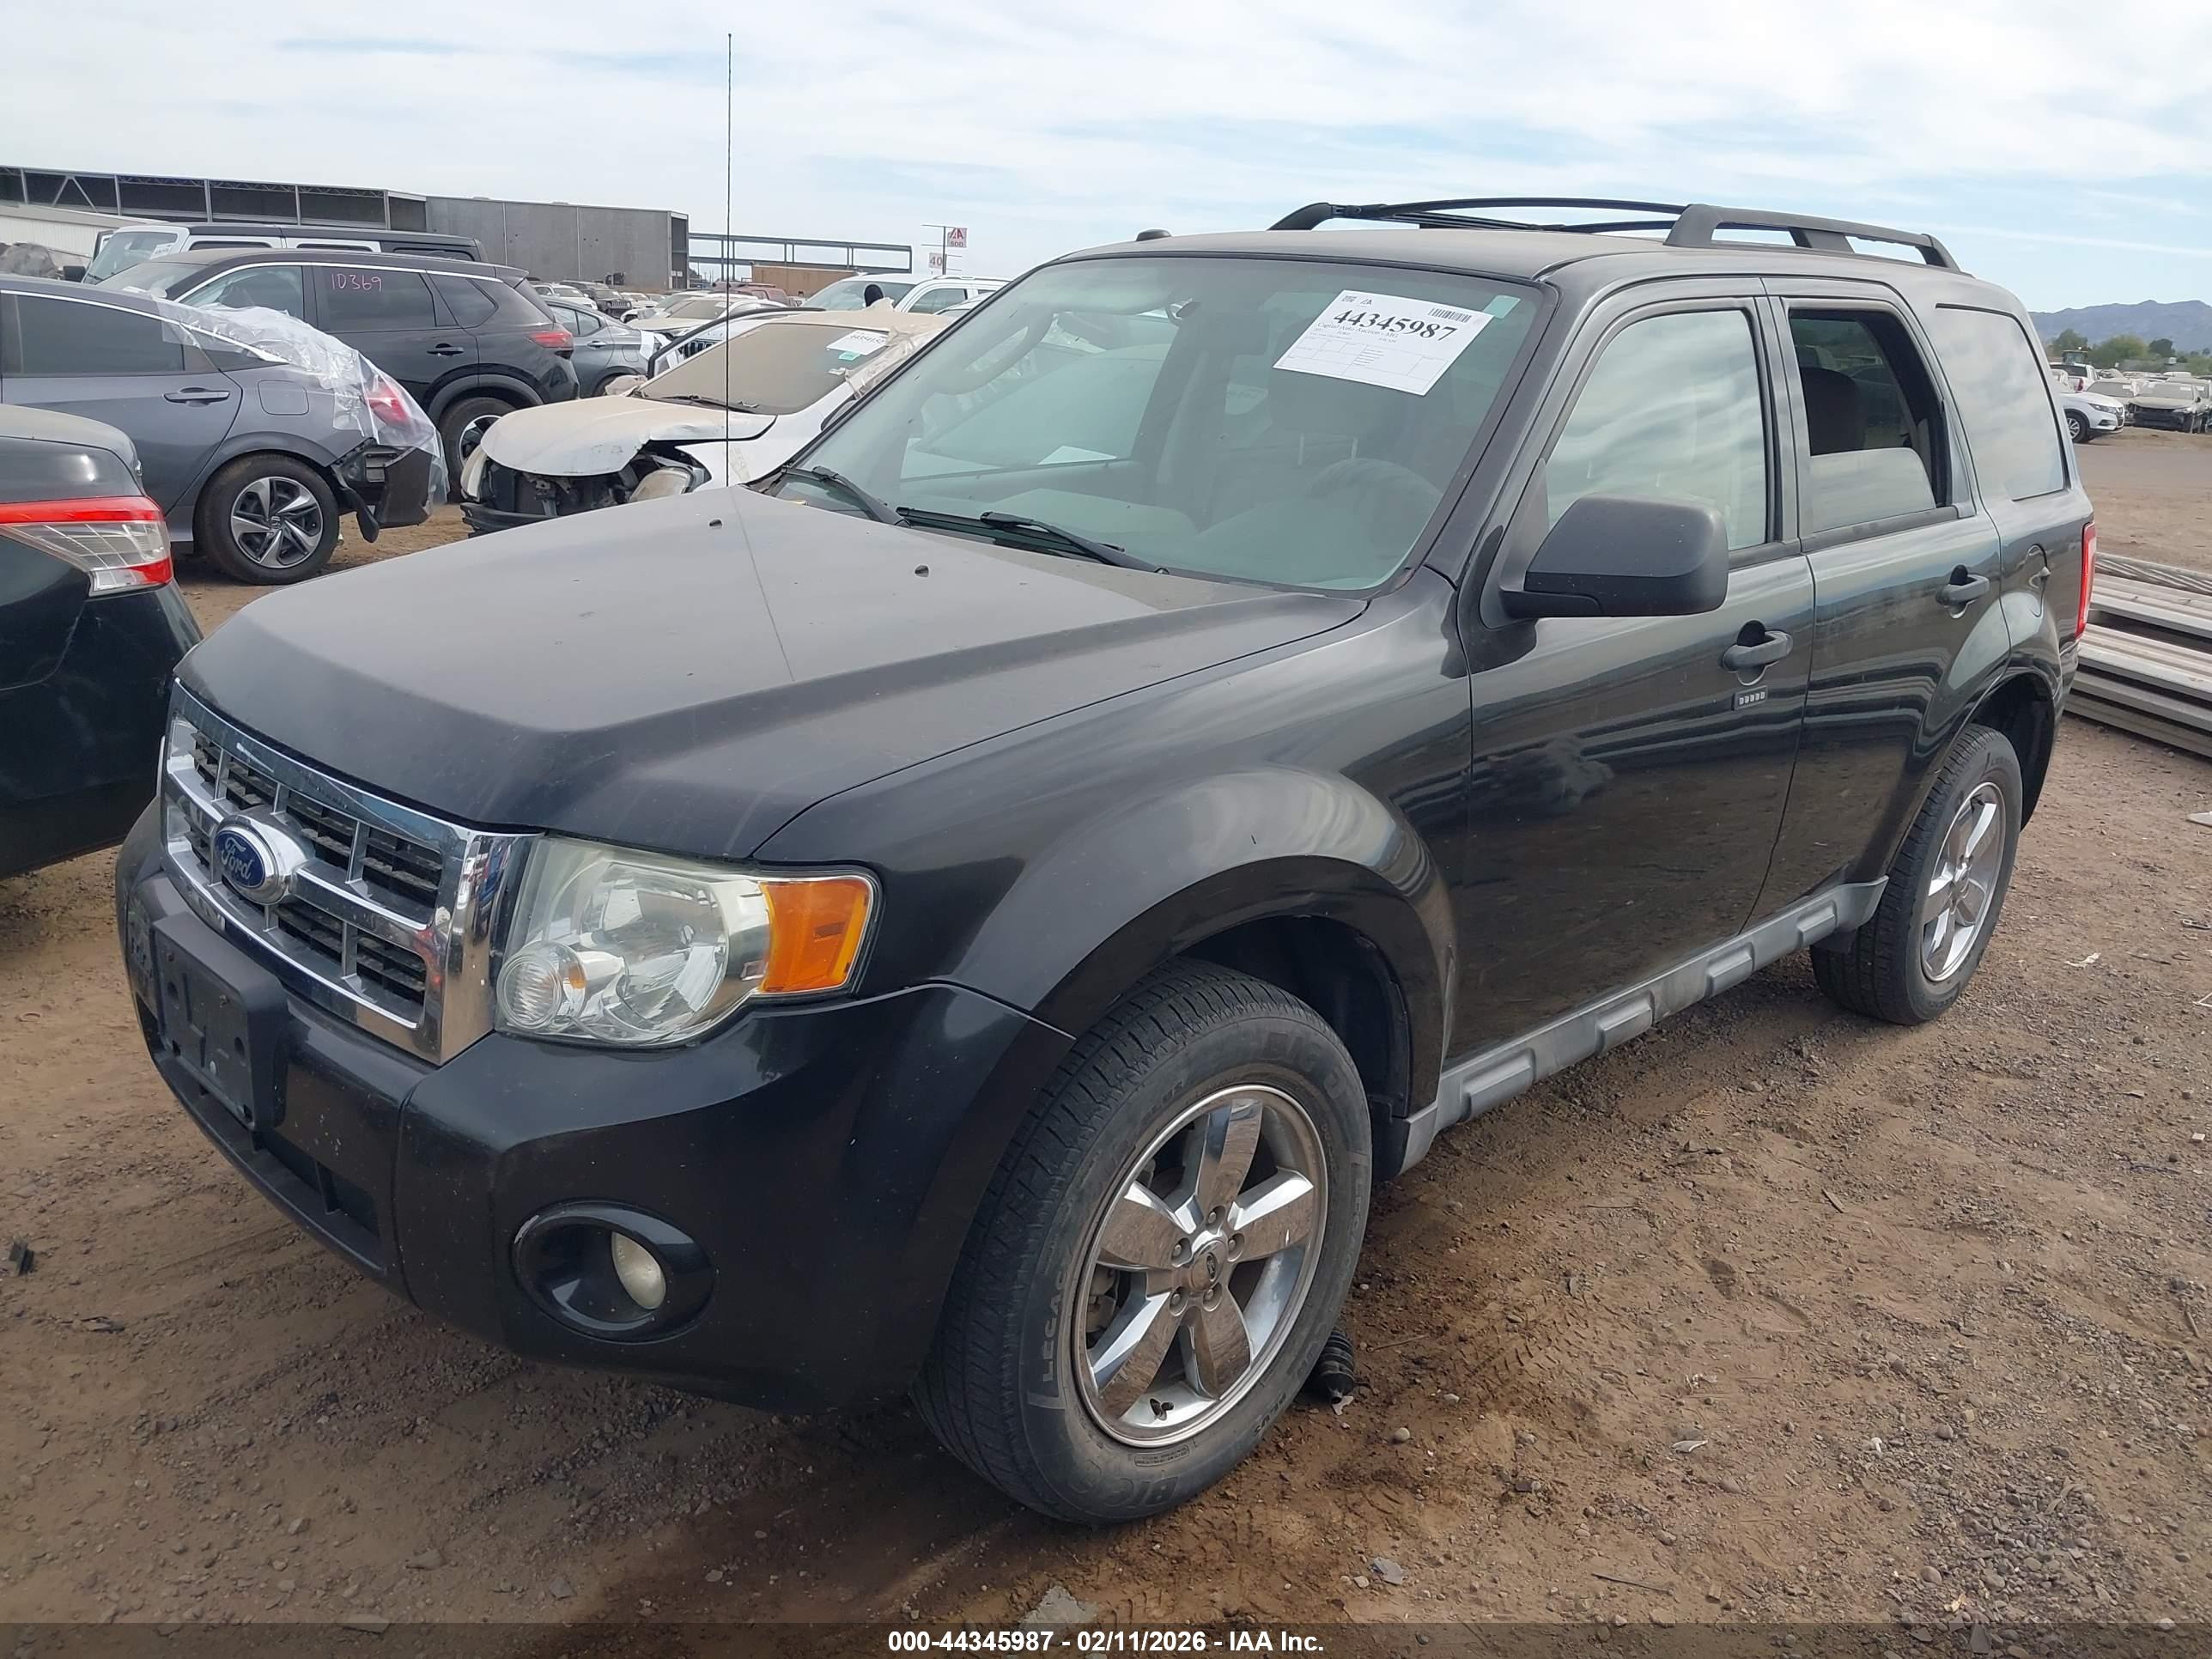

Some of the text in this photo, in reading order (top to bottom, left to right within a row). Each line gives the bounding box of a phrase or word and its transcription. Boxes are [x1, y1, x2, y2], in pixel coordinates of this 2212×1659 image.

[930, 257, 942, 266] 40
[1333, 309, 1459, 342] 44345987
[221, 836, 255, 880] Ford
